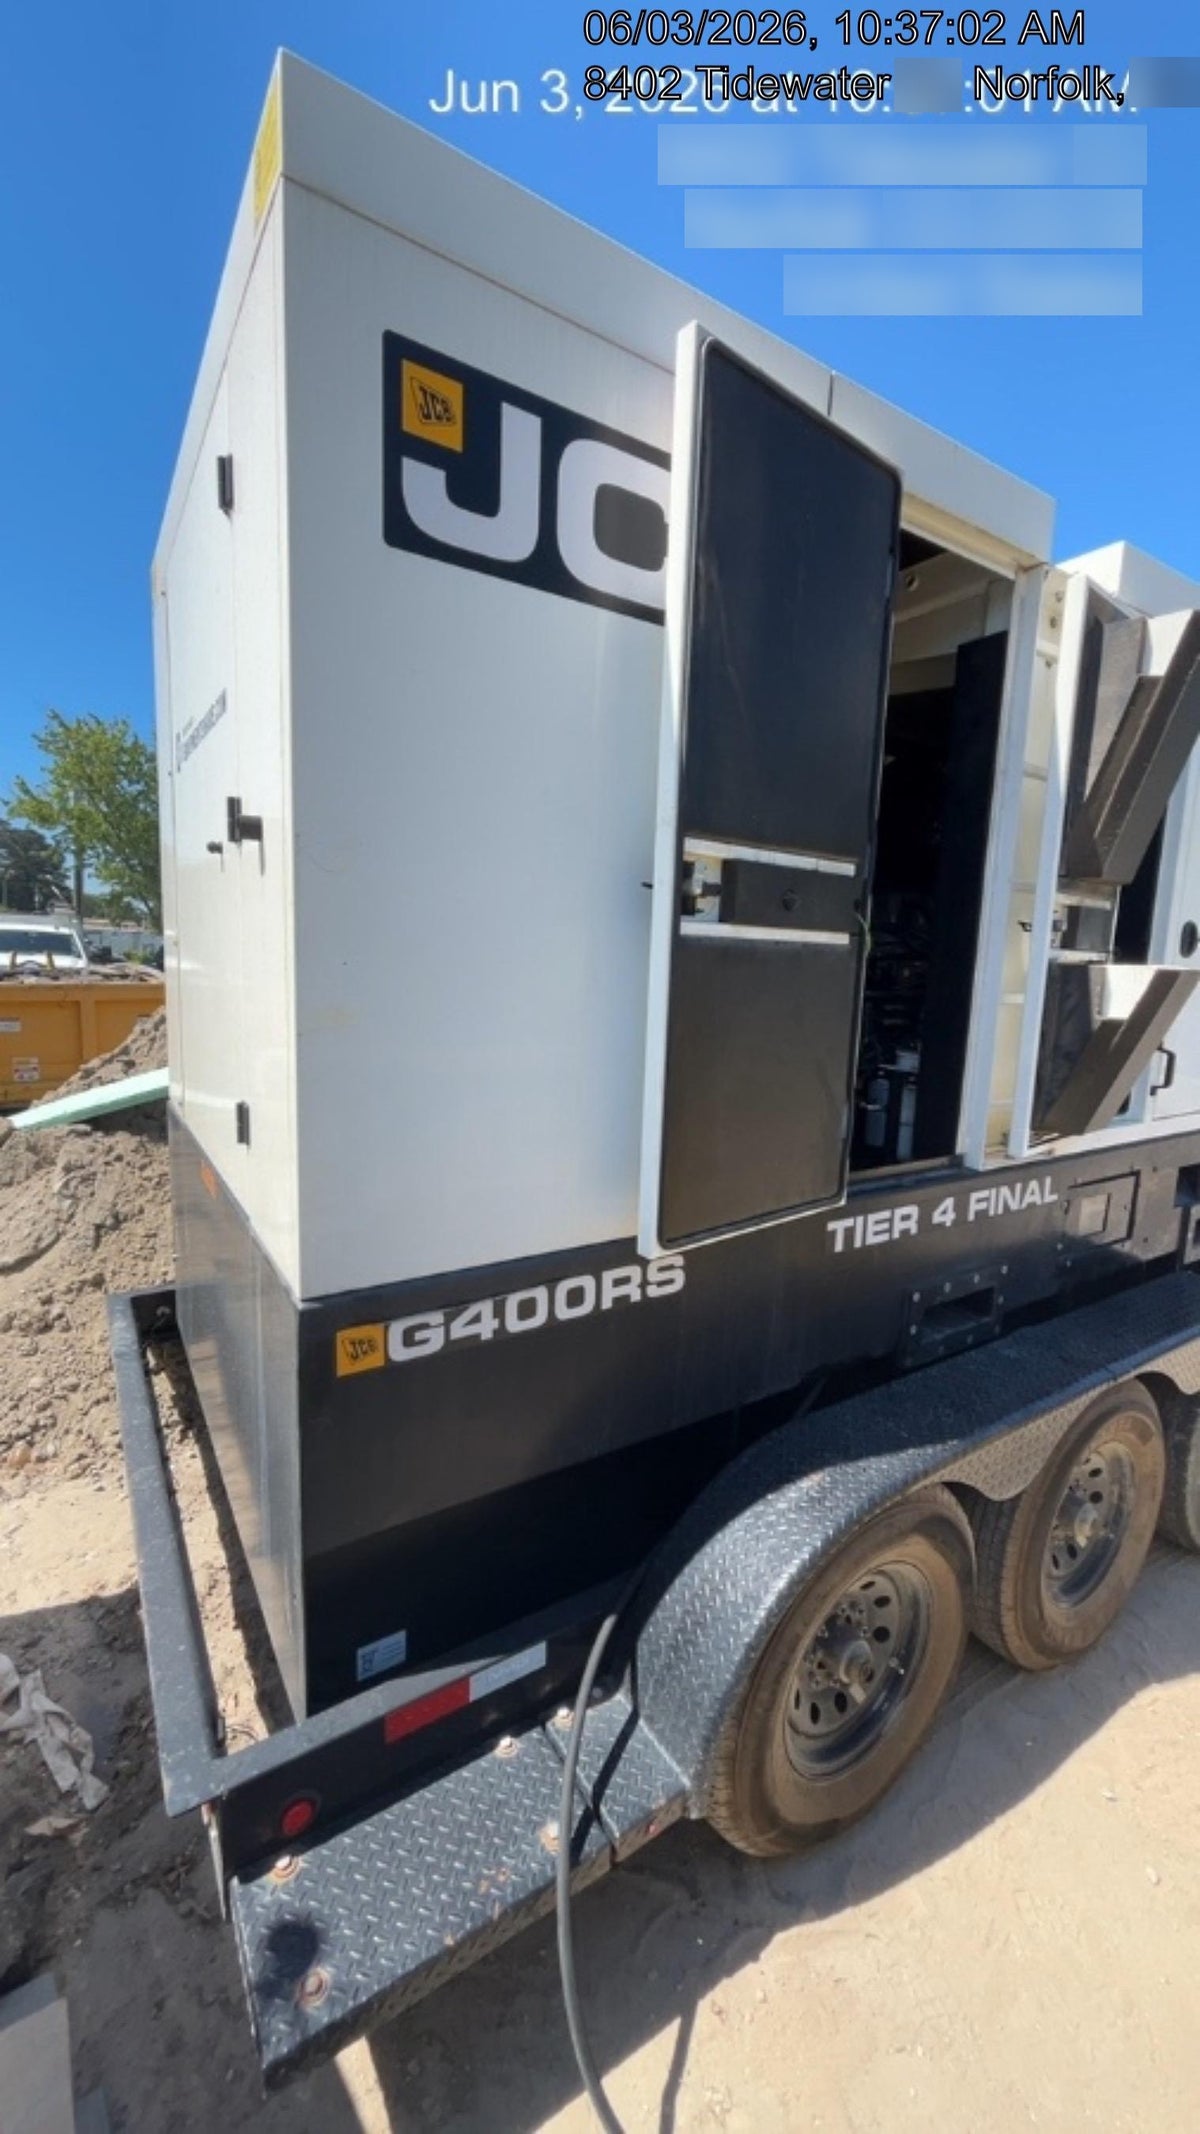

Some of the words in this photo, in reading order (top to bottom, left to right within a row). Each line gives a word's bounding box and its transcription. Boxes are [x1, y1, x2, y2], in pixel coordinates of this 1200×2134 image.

[402, 401, 671, 612] JC
[827, 1204, 919, 1253] TIER
[931, 1196, 957, 1227] 4
[967, 1175, 1059, 1222] FINAL
[388, 1253, 686, 1362] G400RS
